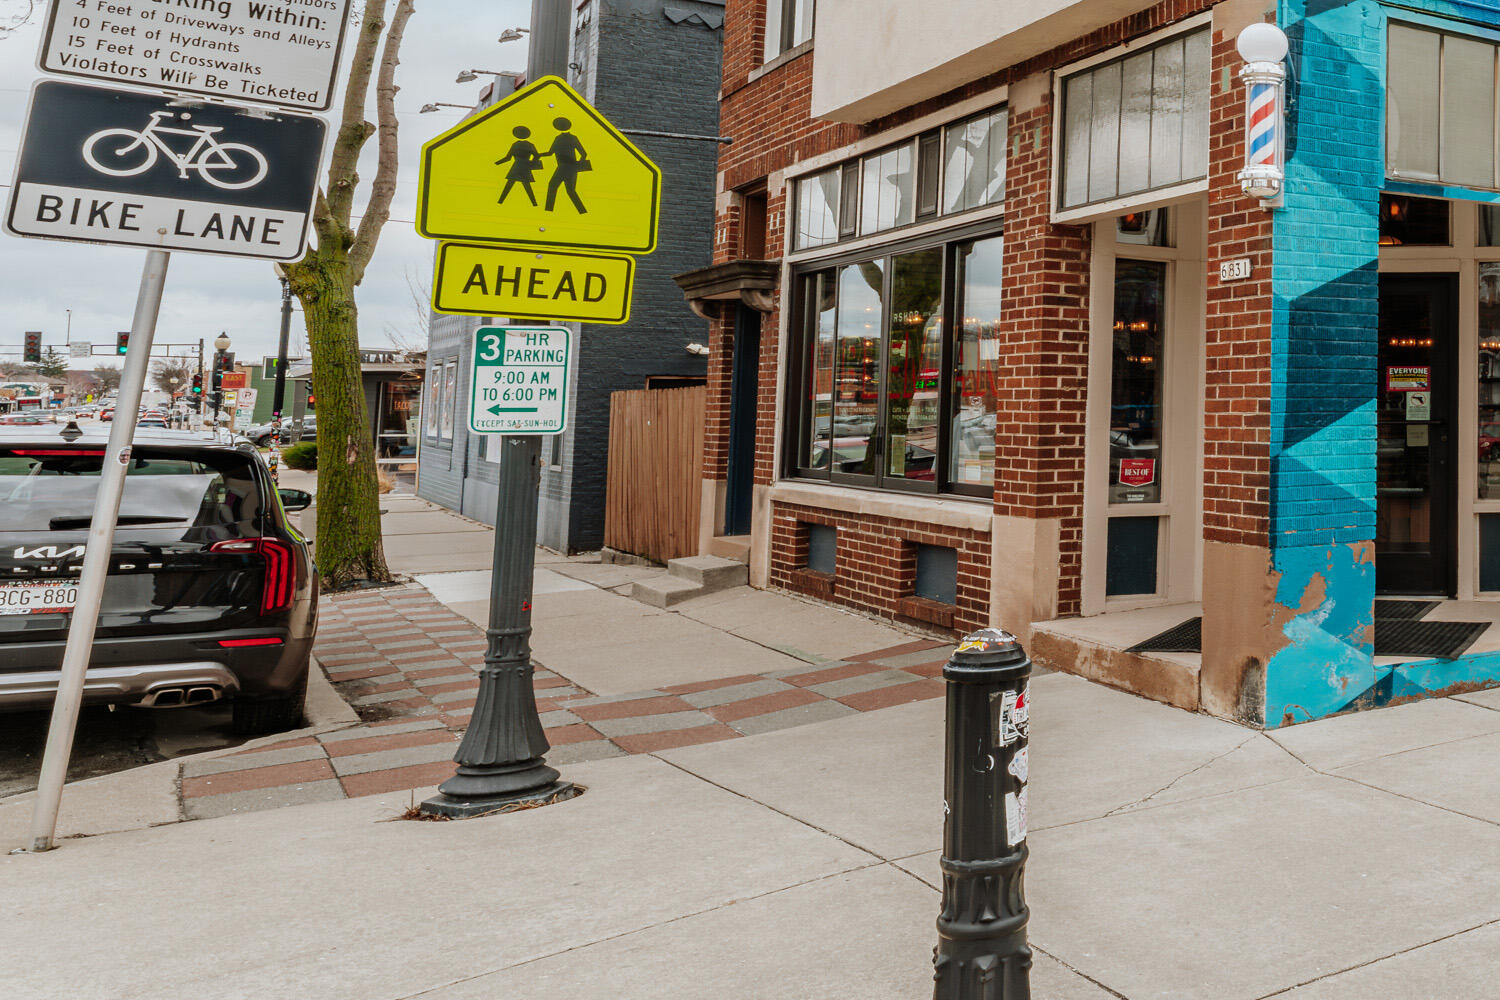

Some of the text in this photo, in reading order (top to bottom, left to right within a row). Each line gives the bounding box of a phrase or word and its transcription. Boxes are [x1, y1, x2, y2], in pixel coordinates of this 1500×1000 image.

[97, 1, 132, 17] Feet
[140, 6, 156, 20] of
[165, 11, 245, 36] Driveways
[253, 26, 281, 41] and
[288, 32, 332, 50] Alleys
[248, 2, 327, 31] Within:
[72, 15, 240, 53] 10 Feet of Hydrants
[68, 34, 262, 76] 15 Feet of Crosswalks
[59, 52, 319, 104] Violators Will Be Ticketed
[36, 194, 285, 245] BIKE LANE
[461, 263, 607, 303] AHEAD
[1222, 262, 1247, 278] 6831
[480, 333, 549, 362] 3 HR
[506, 349, 564, 363] PARKING
[494, 371, 550, 384] 9:00 AM
[1389, 367, 1428, 375] EVERYONE
[482, 388, 557, 401] TO 6:00 PM
[1124, 468, 1140, 476] BEST
[13, 545, 86, 559] KIA
